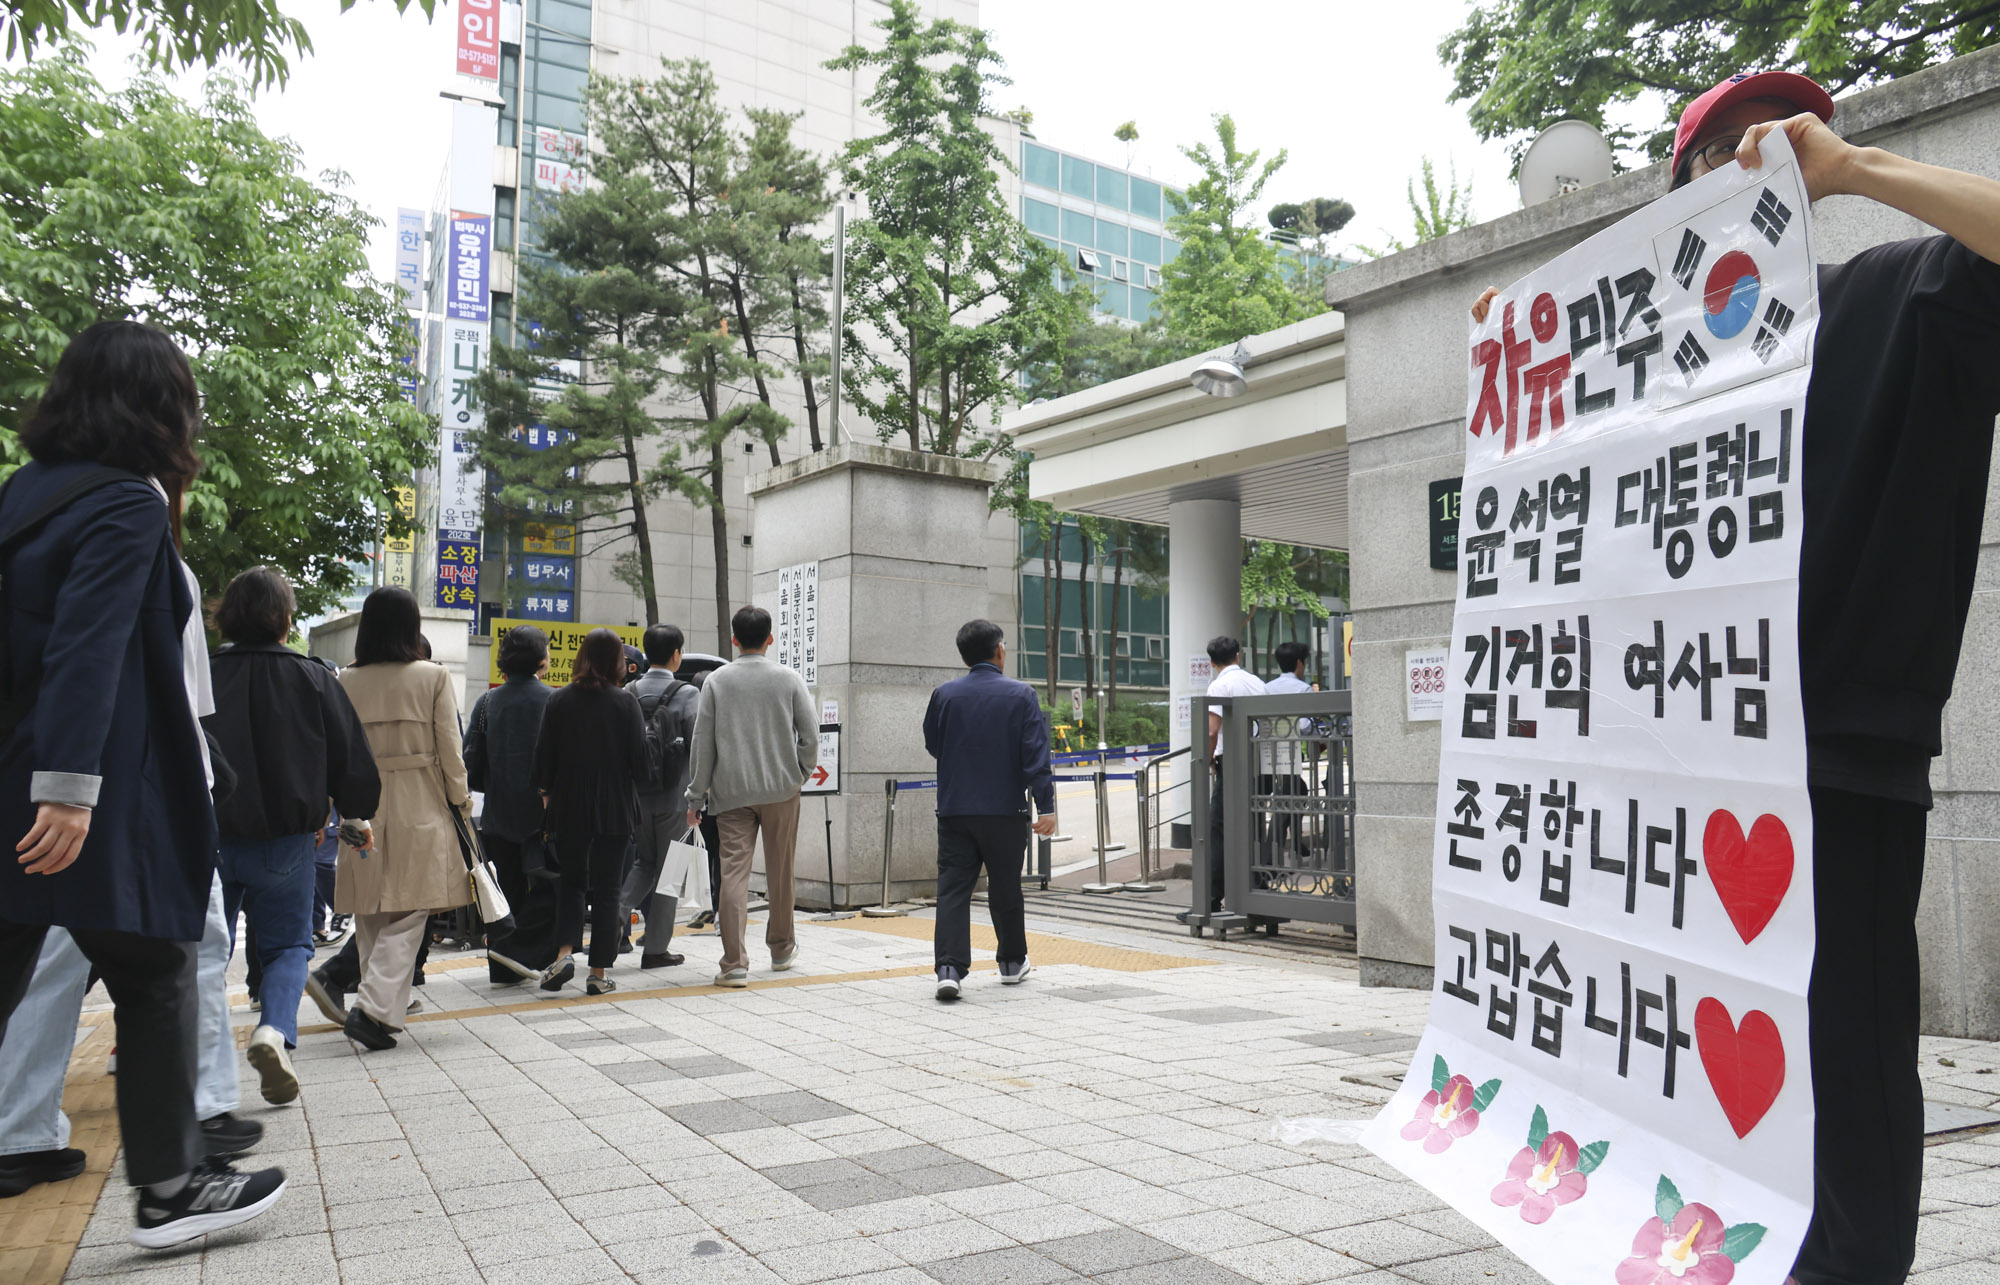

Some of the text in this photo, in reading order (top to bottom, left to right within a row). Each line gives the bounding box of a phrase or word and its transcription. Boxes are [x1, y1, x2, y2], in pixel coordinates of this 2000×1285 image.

[458, 48, 497, 67] 02-577-5121
[454, 220, 486, 235] 법무사
[457, 233, 481, 303] 유경민
[454, 328, 479, 342] 로펌
[1465, 408, 1793, 599] 윤석열 대통령님
[447, 530, 472, 541] 202호
[441, 545, 478, 565] 소장
[439, 564, 479, 585] 파산
[527, 563, 570, 580] 법무사
[440, 585, 477, 605] 상속
[526, 597, 569, 613] 류재봉
[793, 568, 801, 674] 서울중앙지방법
[806, 565, 816, 683] 서울고등법원
[1461, 615, 1770, 740] 김건희 여사님
[1447, 778, 1698, 930] 존경합니다
[1442, 924, 1691, 1100] 고맙습니다
